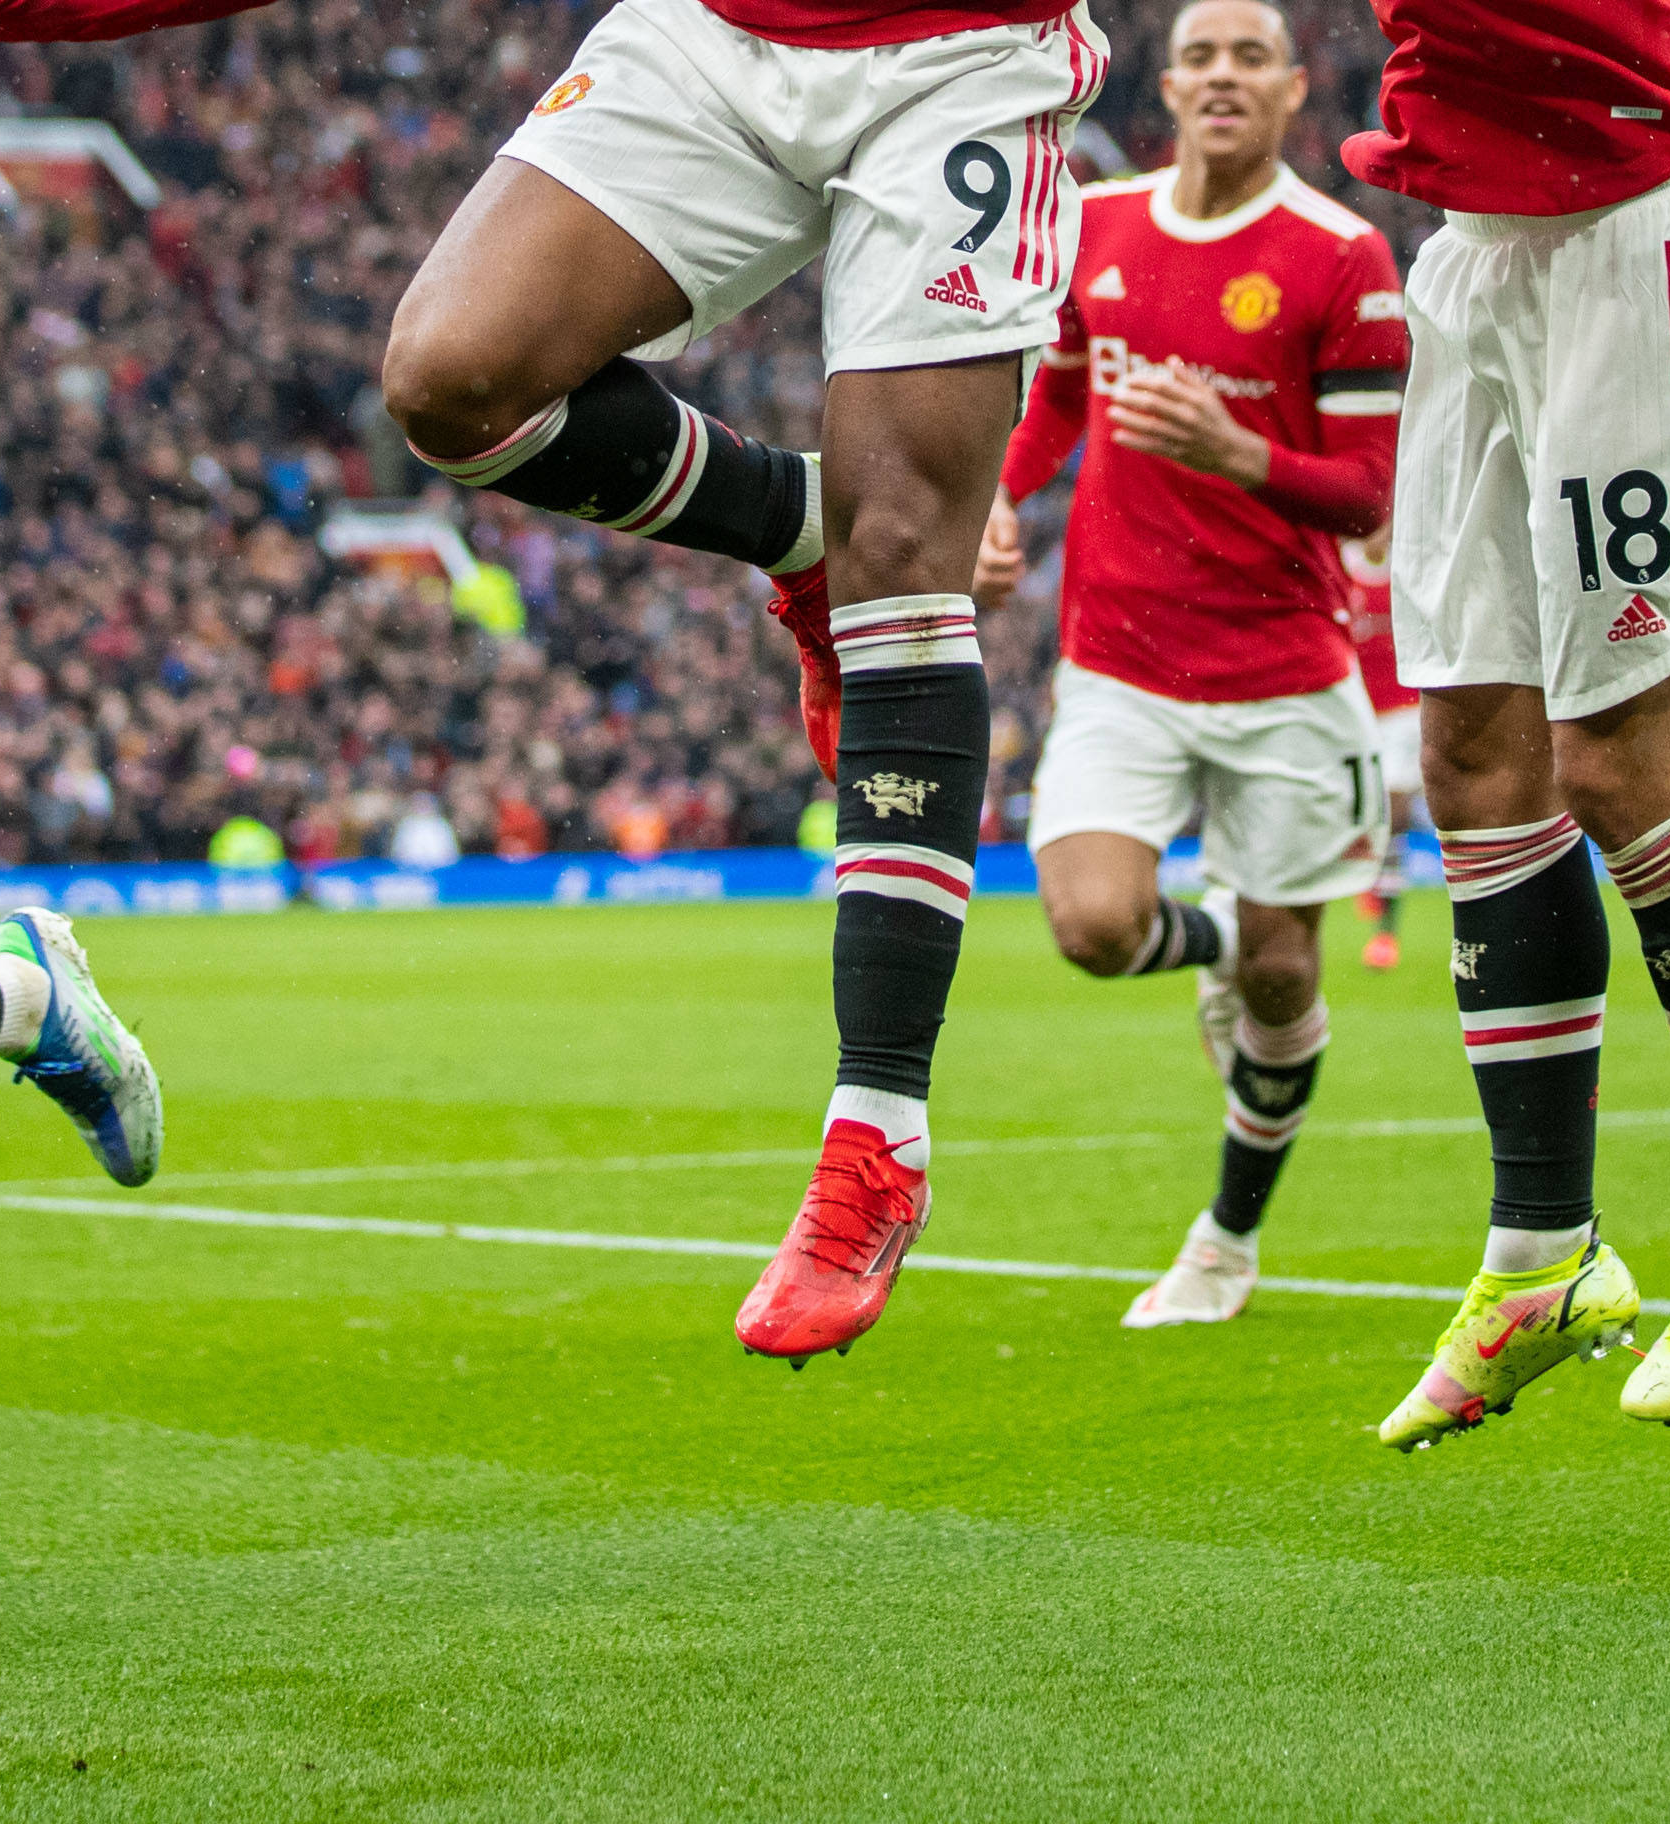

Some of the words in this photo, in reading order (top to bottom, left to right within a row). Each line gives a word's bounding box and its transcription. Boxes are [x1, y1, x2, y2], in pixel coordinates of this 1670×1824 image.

[943, 139, 1013, 254] 9
[924, 286, 988, 313] adidas
[1607, 618, 1667, 643] adidas
